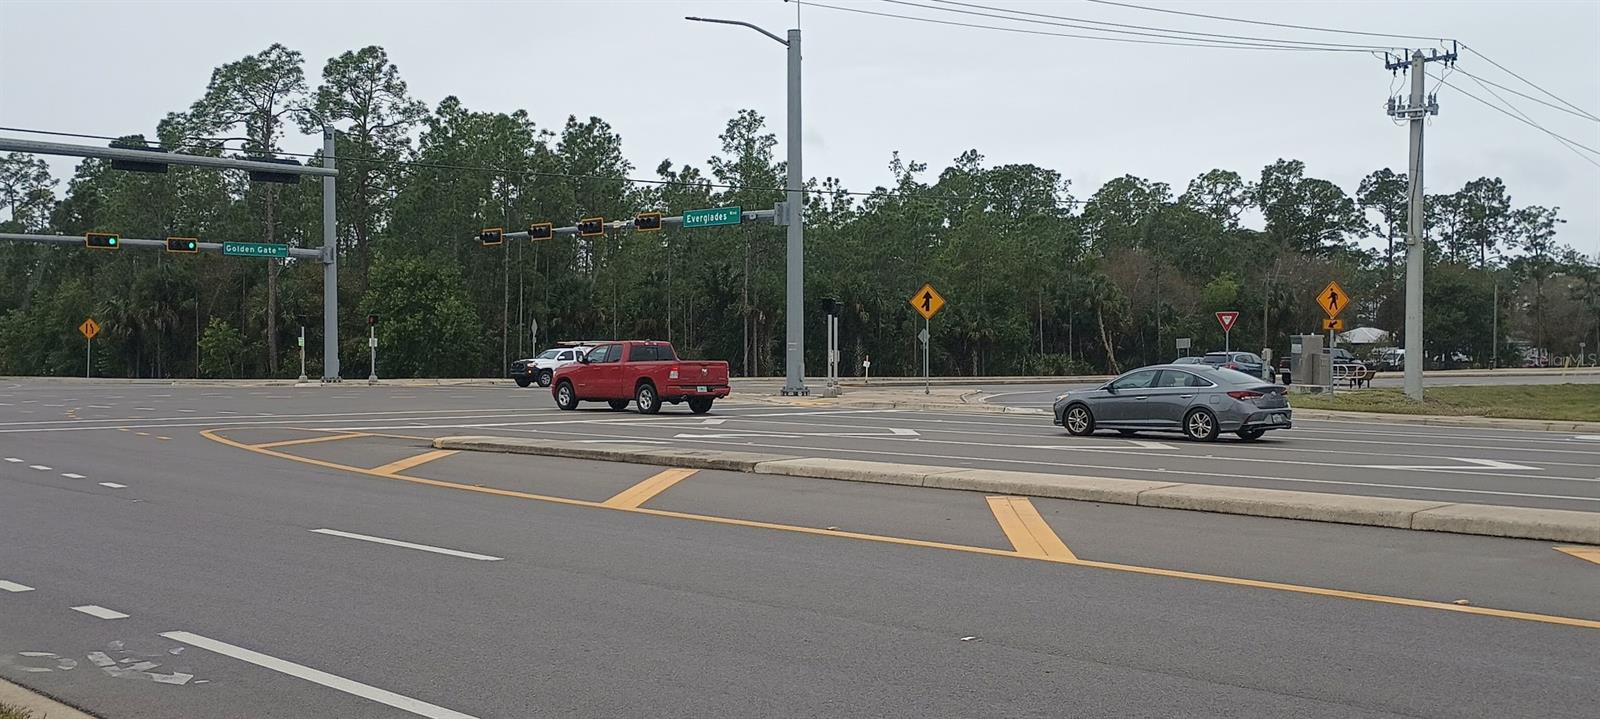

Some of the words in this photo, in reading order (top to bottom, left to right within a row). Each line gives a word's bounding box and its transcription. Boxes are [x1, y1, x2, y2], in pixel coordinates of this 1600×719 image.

[686, 213, 727, 224] Everglades
[226, 245, 255, 253] Golden
[257, 246, 277, 254] Gate
